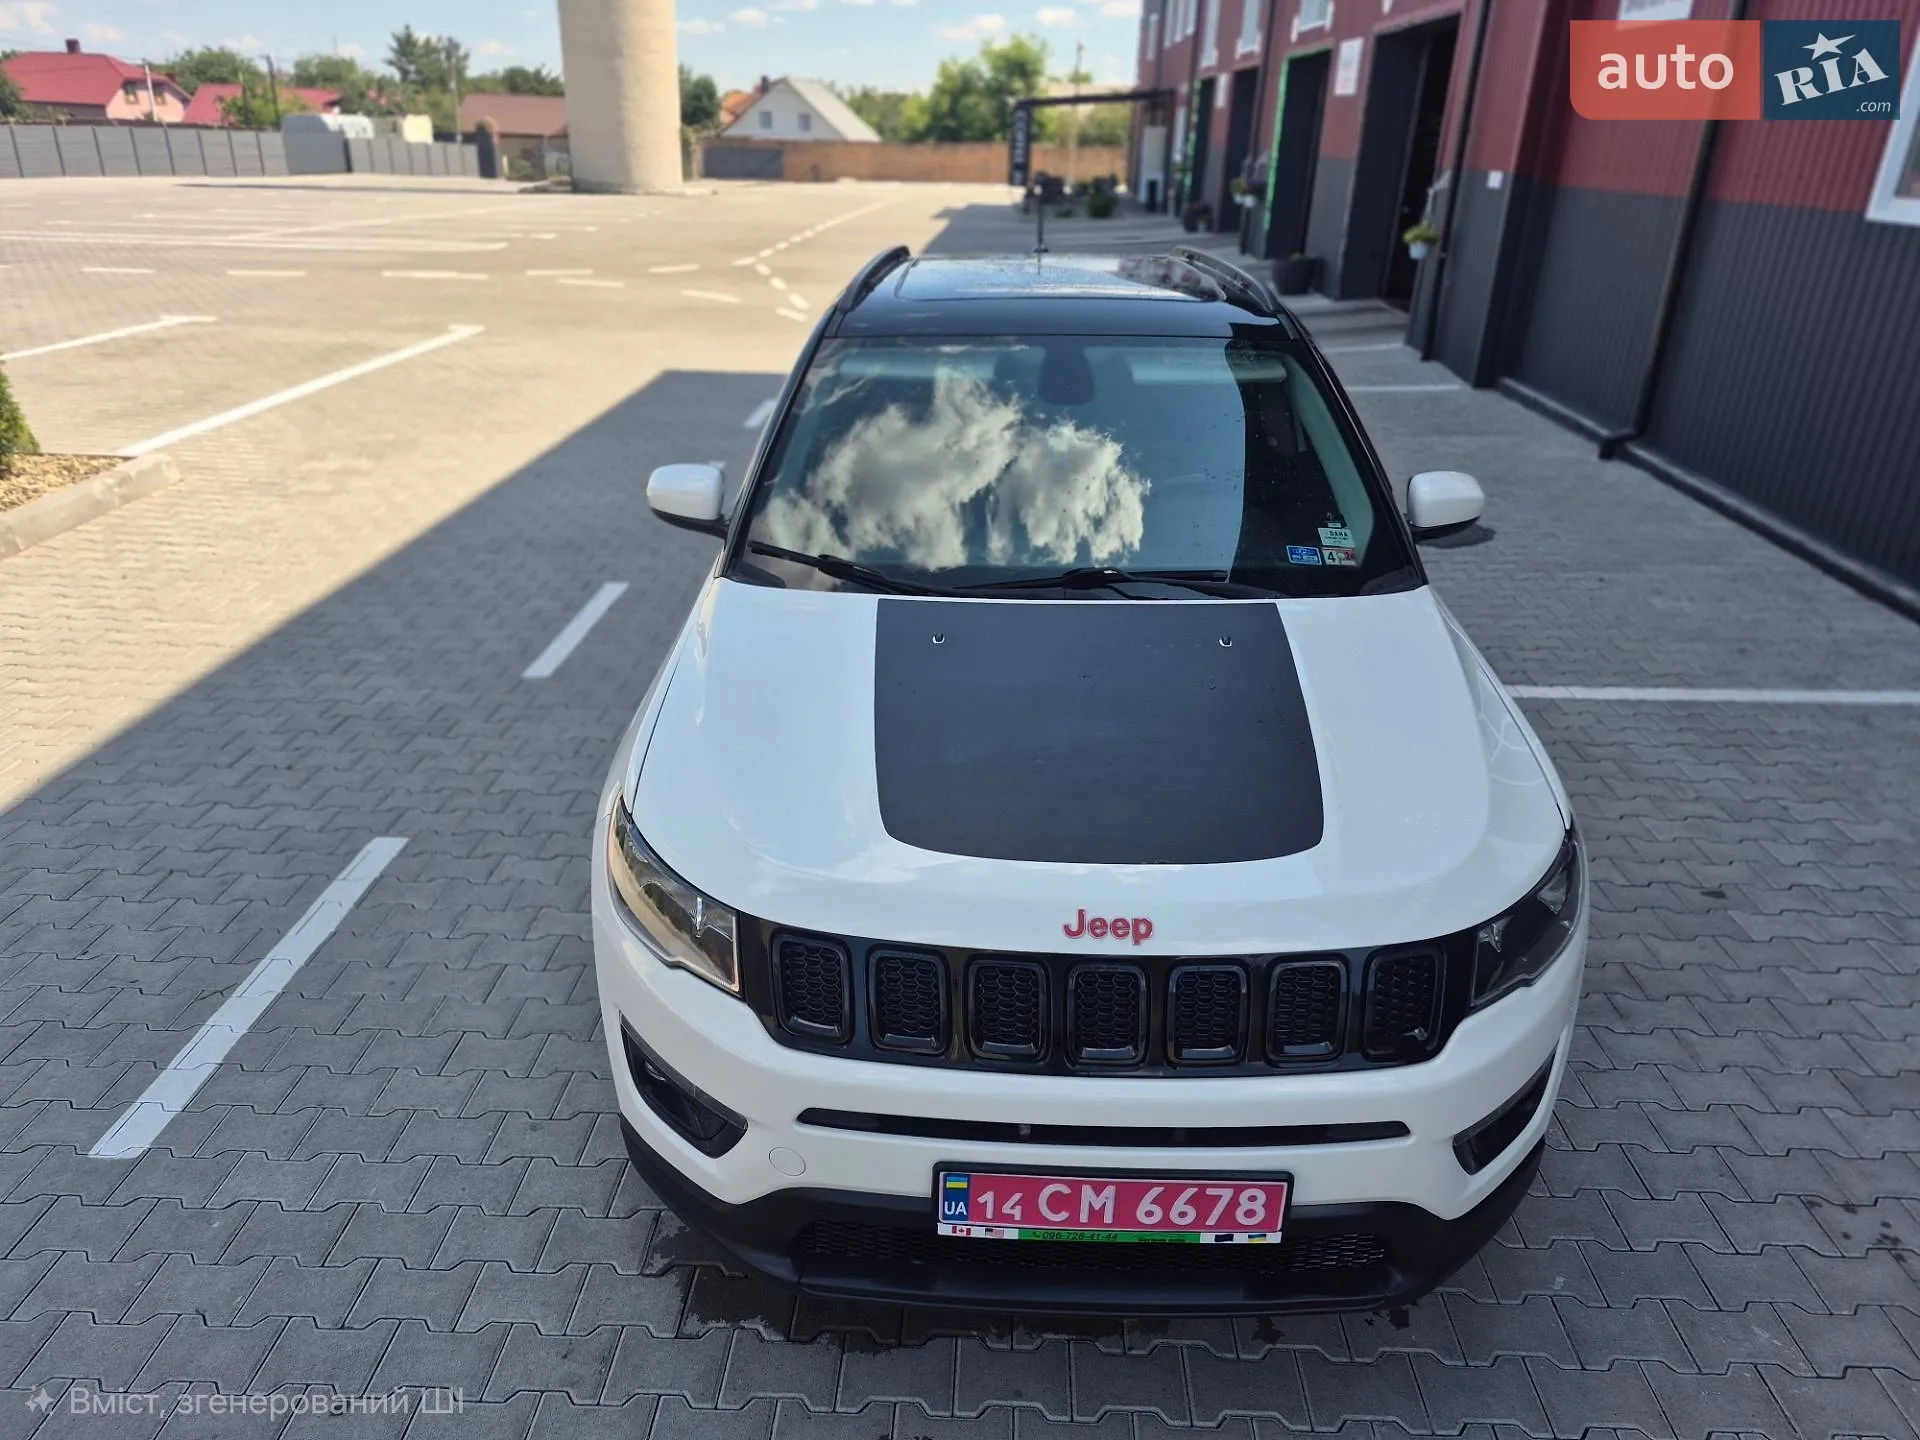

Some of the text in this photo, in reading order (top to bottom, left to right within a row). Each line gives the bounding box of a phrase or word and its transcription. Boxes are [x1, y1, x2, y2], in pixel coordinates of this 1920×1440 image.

[1063, 908, 1153, 945] Jeep
[944, 1201, 967, 1215] UA
[977, 1183, 1267, 1227] 14 CM 6678
